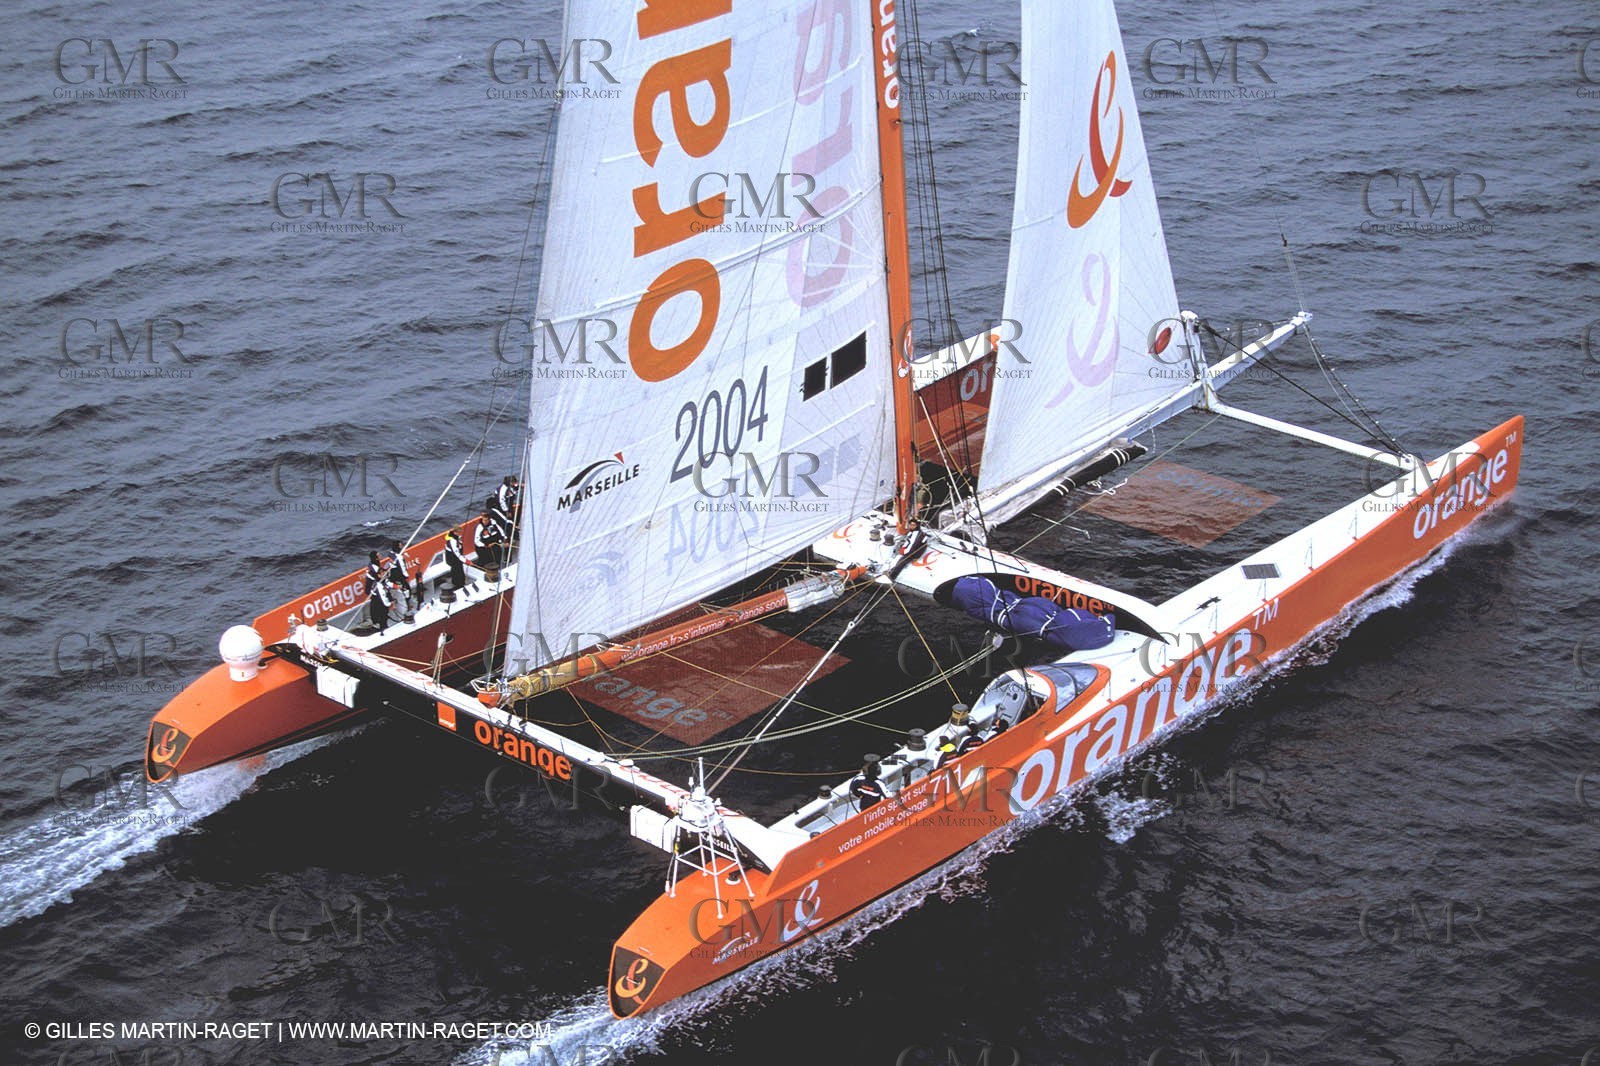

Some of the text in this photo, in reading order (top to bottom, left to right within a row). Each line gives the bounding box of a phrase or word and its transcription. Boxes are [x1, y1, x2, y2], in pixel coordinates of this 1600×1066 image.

[669, 365, 769, 484] 2004
[557, 464, 640, 511] MARSEILLE
[1413, 449, 1508, 539] orange
[303, 581, 365, 620] orange
[583, 671, 707, 726] ange
[1009, 627, 1253, 816] orange
[474, 720, 573, 780] orange
[838, 835, 863, 854] votre
[864, 817, 895, 840] mobile
